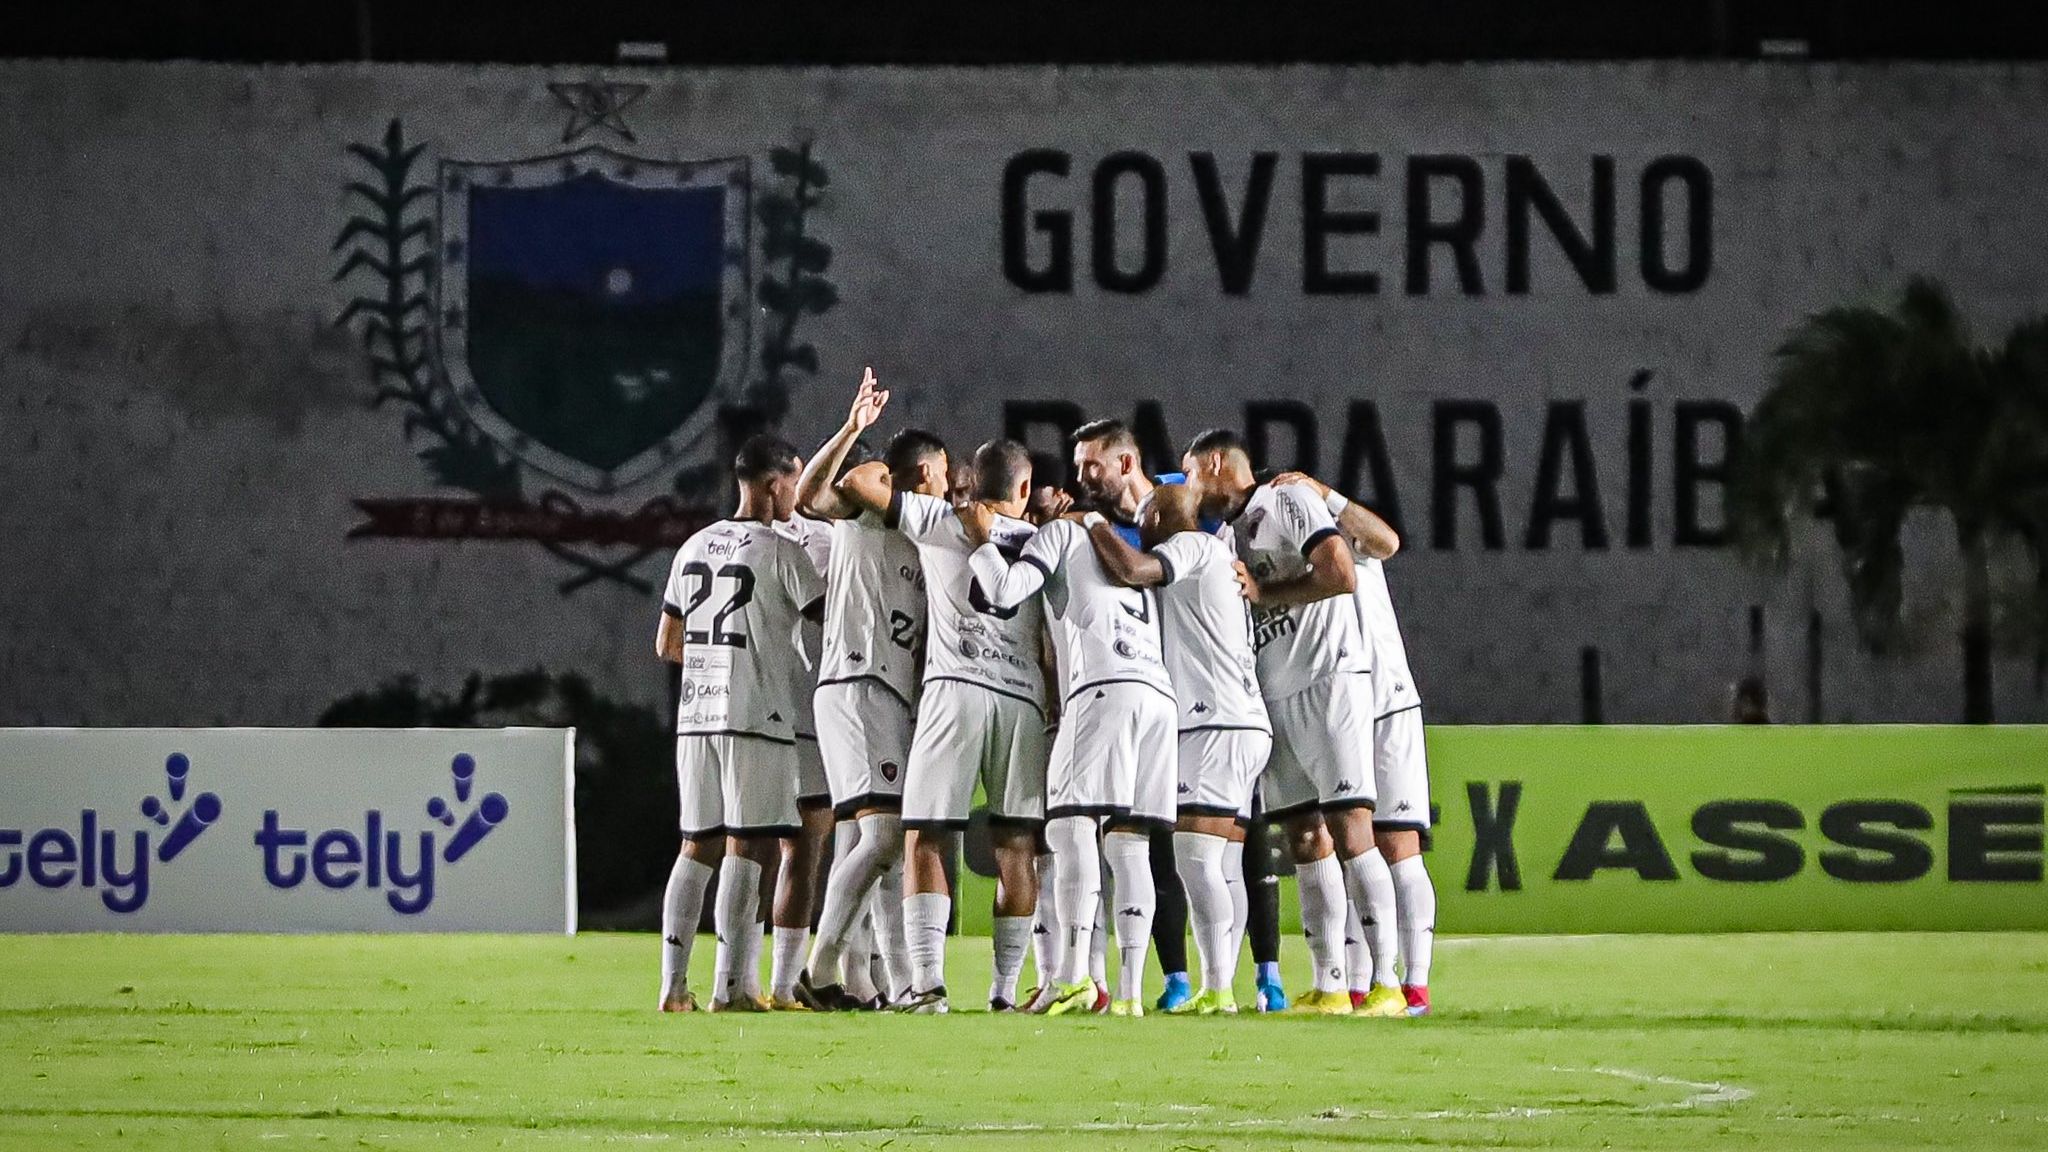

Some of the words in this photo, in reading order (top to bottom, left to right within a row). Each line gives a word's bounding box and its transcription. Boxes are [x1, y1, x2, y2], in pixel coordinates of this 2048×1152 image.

[1003, 147, 1714, 296] GOVERNO
[1245, 368, 1748, 550] PARAÍB
[682, 561, 756, 649] 22
[707, 540, 737, 561] tely
[254, 808, 435, 915] tely
[1465, 779, 1523, 892] X
